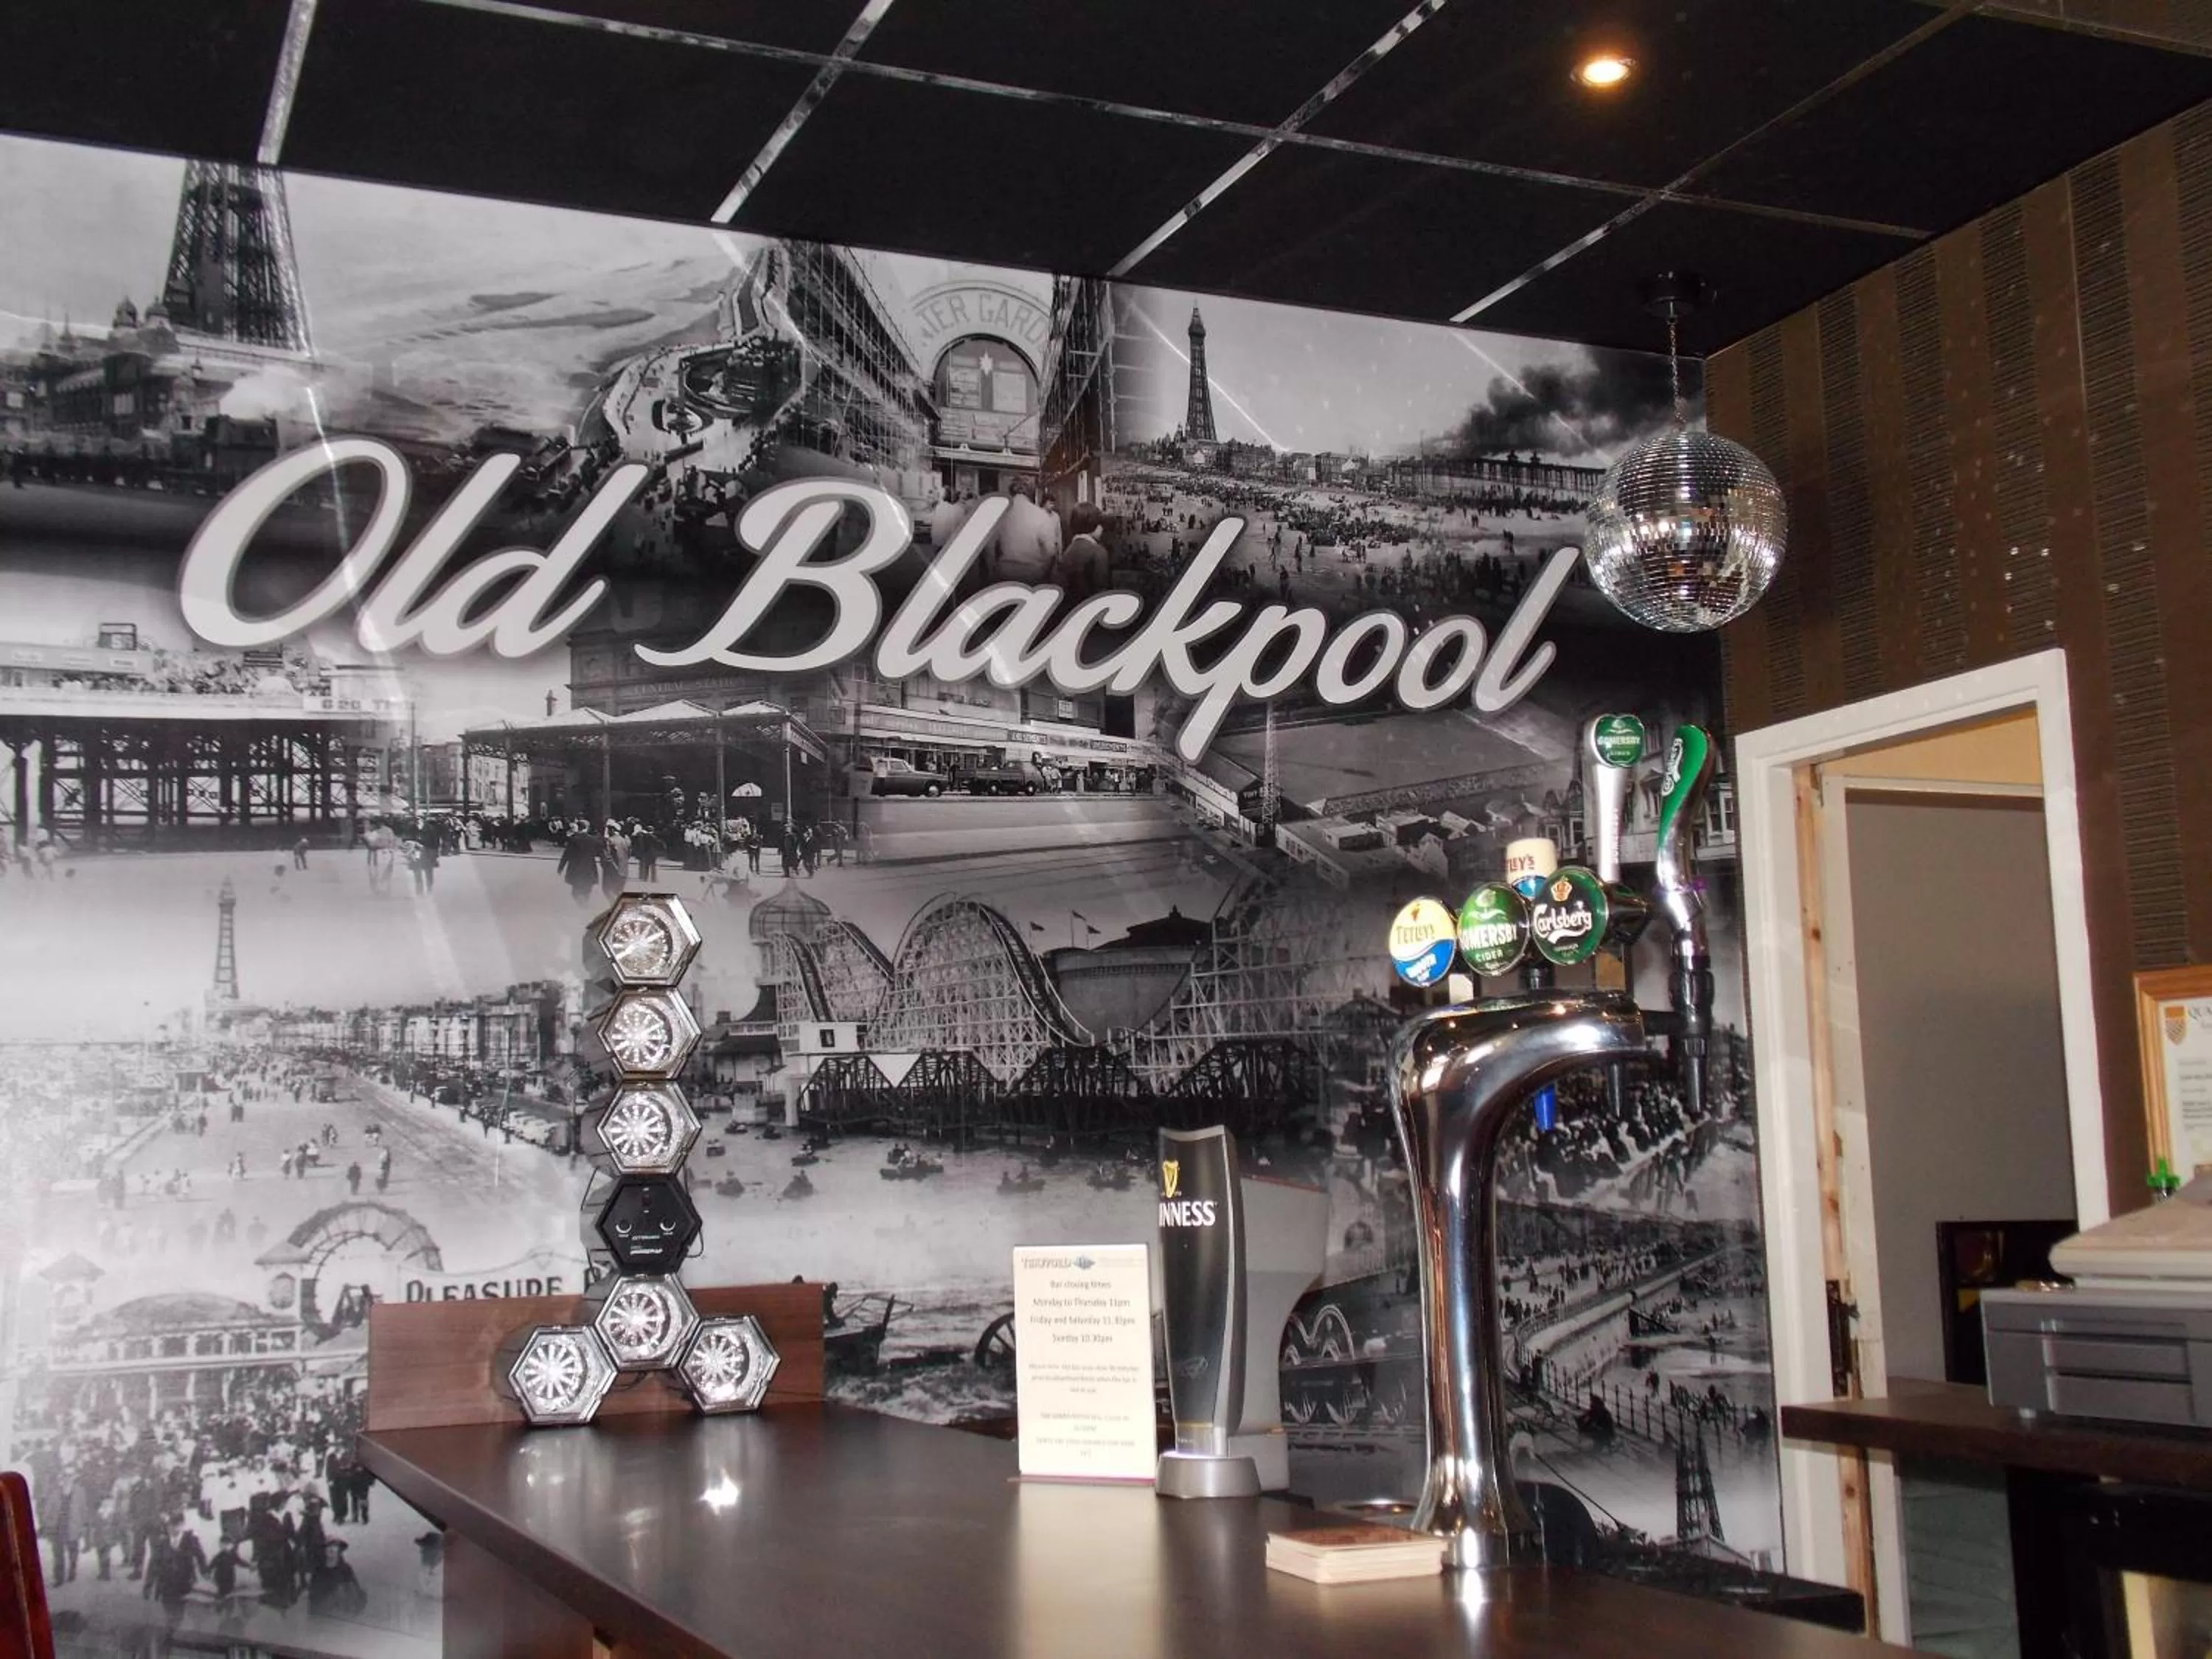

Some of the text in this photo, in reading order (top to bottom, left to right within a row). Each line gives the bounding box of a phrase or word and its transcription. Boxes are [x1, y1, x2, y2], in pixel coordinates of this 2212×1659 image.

[179, 437, 1581, 762] Old Blackpool
[1533, 901, 1593, 945] Carlsberg
[1475, 949, 1503, 962] CIDER
